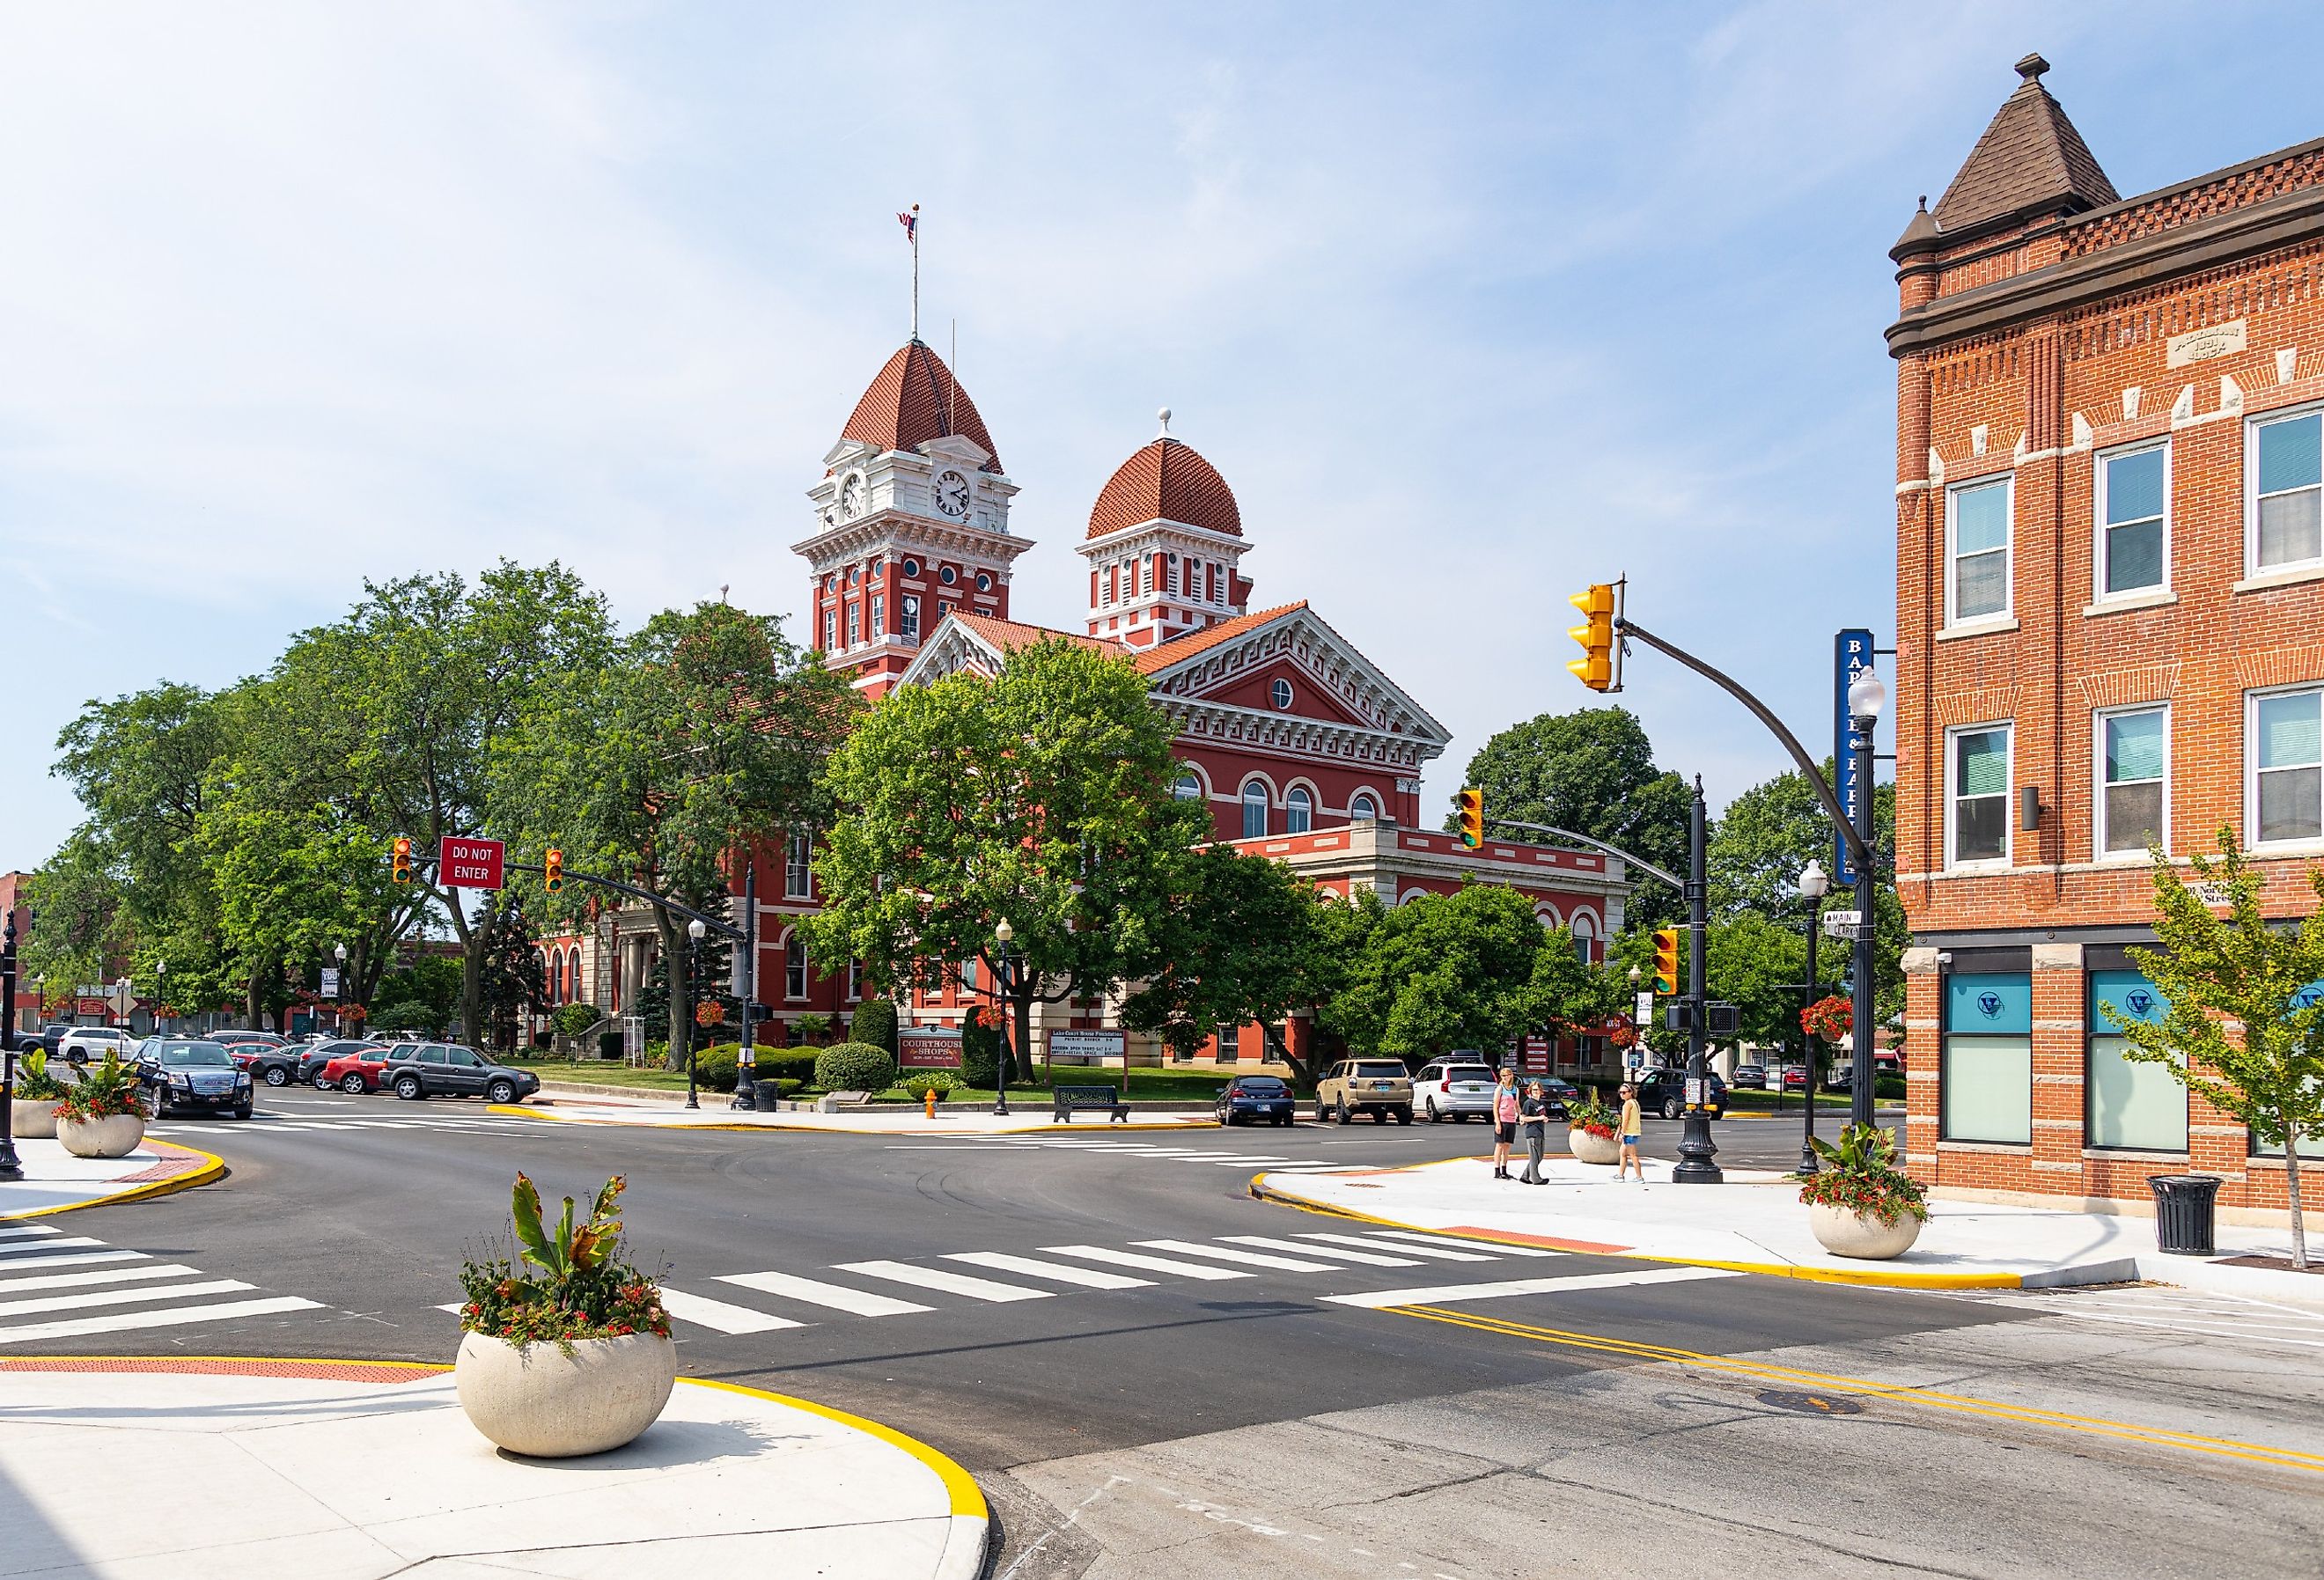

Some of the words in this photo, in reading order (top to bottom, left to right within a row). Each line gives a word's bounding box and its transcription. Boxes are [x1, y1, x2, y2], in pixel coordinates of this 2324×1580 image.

[452, 846, 467, 859] DO
[471, 848, 492, 861] NOT
[454, 865, 489, 880] ENTER
[1833, 914, 1851, 922] MAIN
[1834, 925, 1853, 937] CLARK
